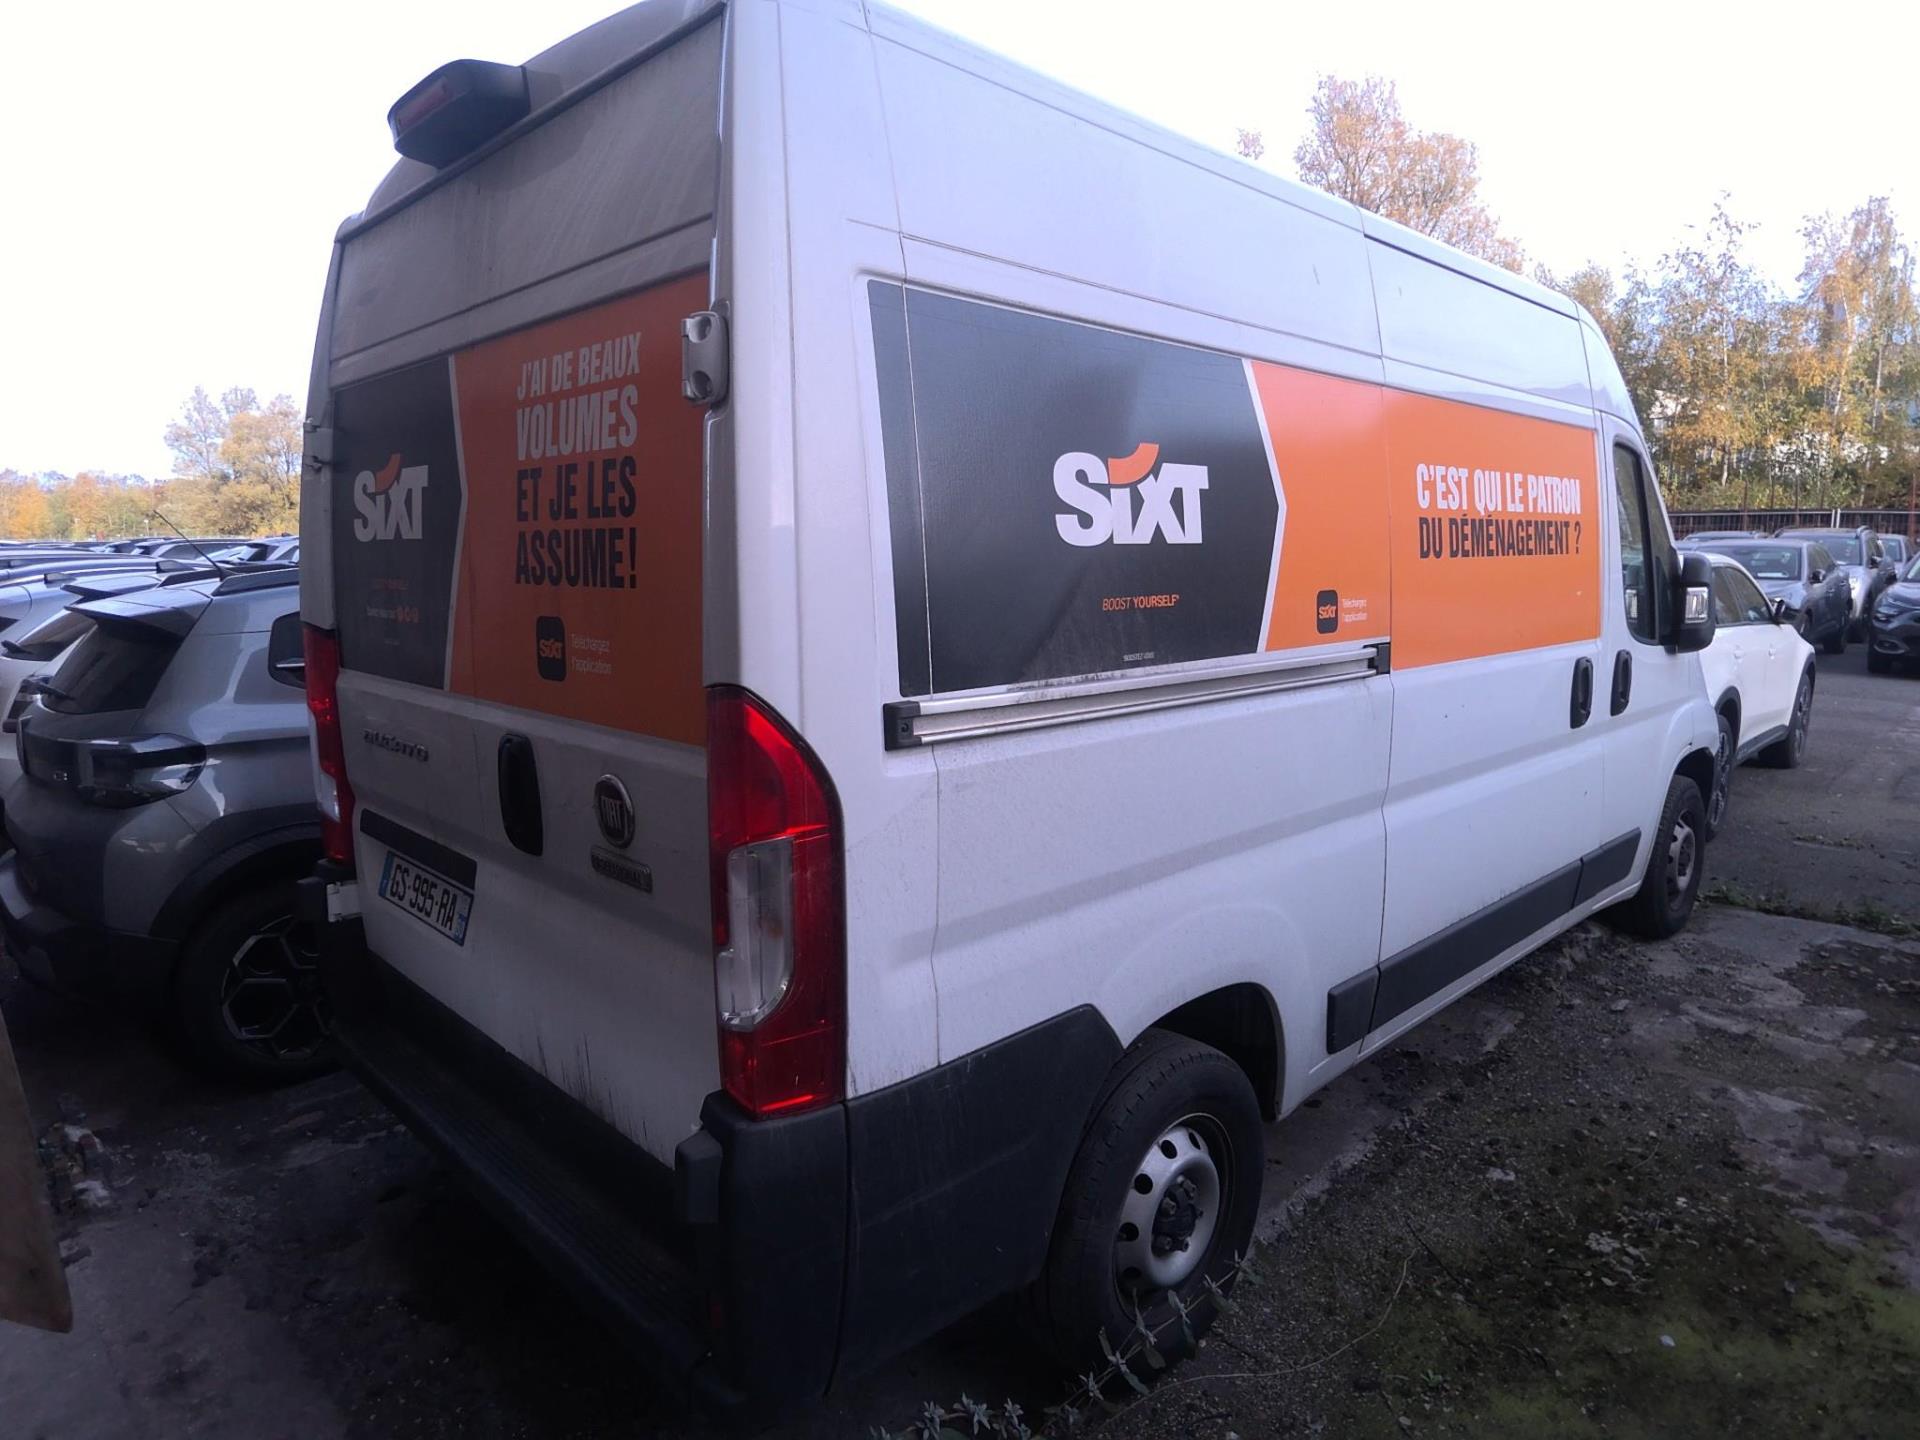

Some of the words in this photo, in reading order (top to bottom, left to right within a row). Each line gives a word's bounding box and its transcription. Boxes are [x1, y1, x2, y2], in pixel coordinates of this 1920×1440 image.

[517, 358, 547, 401] J'AI
[551, 351, 573, 393] DE
[577, 331, 641, 387] BEAUX
[516, 383, 639, 461] VOLUMES
[517, 467, 542, 522] ET
[549, 463, 578, 521] JE
[587, 455, 637, 519] LES
[1416, 463, 1469, 510] C'EST
[1473, 468, 1502, 516] QUI
[1505, 472, 1524, 513] LE
[1527, 474, 1581, 515] PATRON
[1419, 517, 1443, 559] DU
[1448, 513, 1570, 558] DÉMÉNAGEMENT
[1102, 597, 1131, 611] BOOST
[390, 863, 458, 932] GS-995-RA
